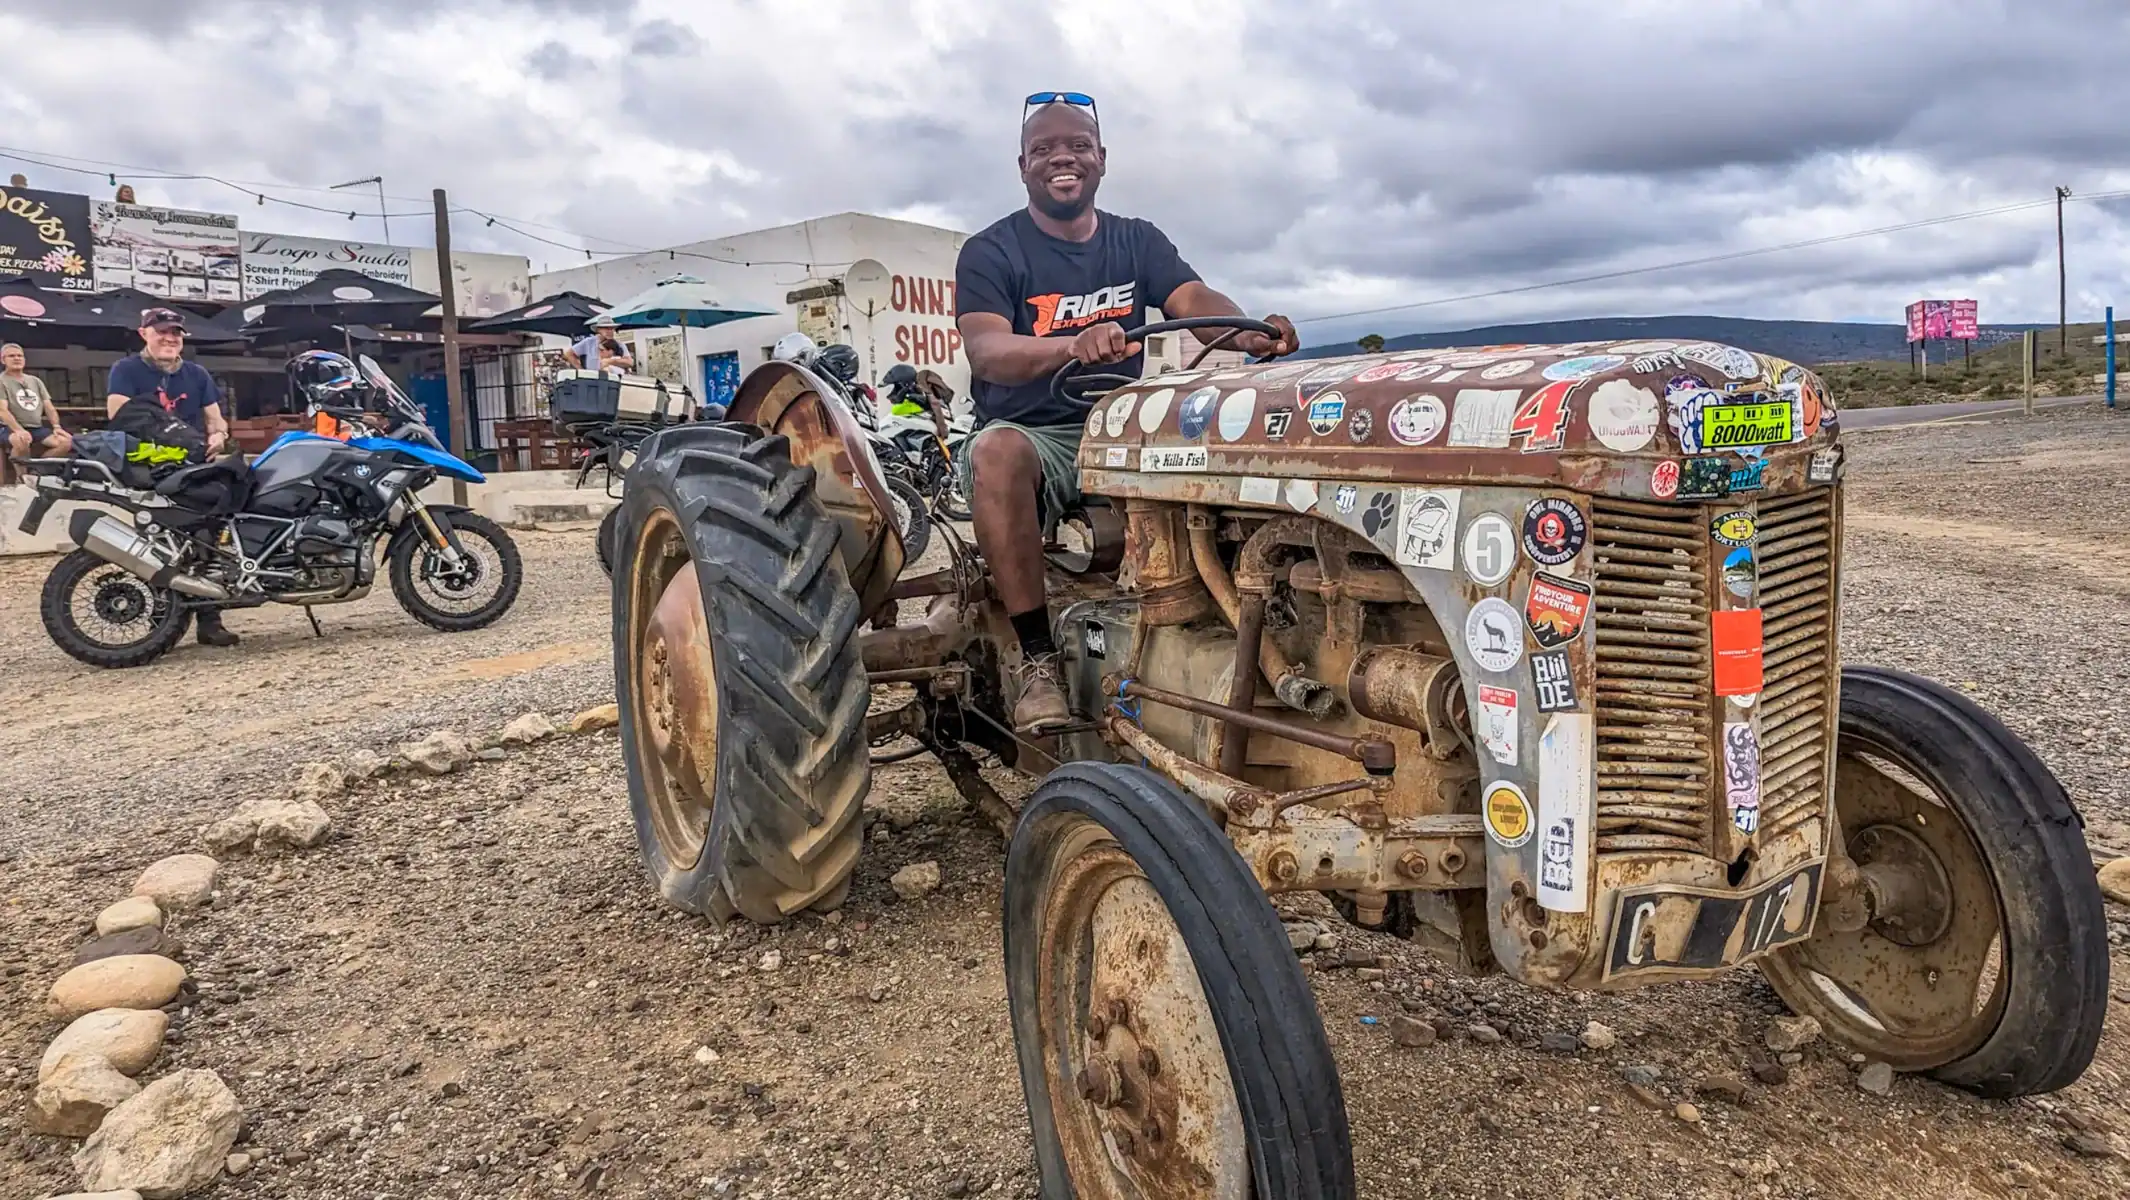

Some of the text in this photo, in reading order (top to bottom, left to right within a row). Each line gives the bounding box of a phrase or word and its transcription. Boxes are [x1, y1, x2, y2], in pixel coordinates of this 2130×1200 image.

[247, 234, 409, 267] Logo Studio
[14, 259, 44, 270] PIZZAS
[245, 264, 280, 275] Screen
[362, 268, 408, 282] Embroidery
[62, 278, 76, 288] 25
[246, 275, 309, 288] T-Shirt Printi
[891, 274, 956, 317] ONNI
[1054, 281, 1136, 321] RIDE
[1052, 305, 1133, 330] EXPEDITIONS
[895, 325, 962, 365] SHOP
[1267, 414, 1289, 436] 21
[1511, 378, 1590, 454] 4
[1711, 421, 1785, 445] 8000watt
[1162, 453, 1206, 467] Killa Fish
[1529, 502, 1546, 519] OWL
[1547, 499, 1584, 531] MIRRORS
[1476, 523, 1502, 578] 5
[1533, 594, 1583, 616] ADVENTURE
[1626, 901, 1656, 965] C
